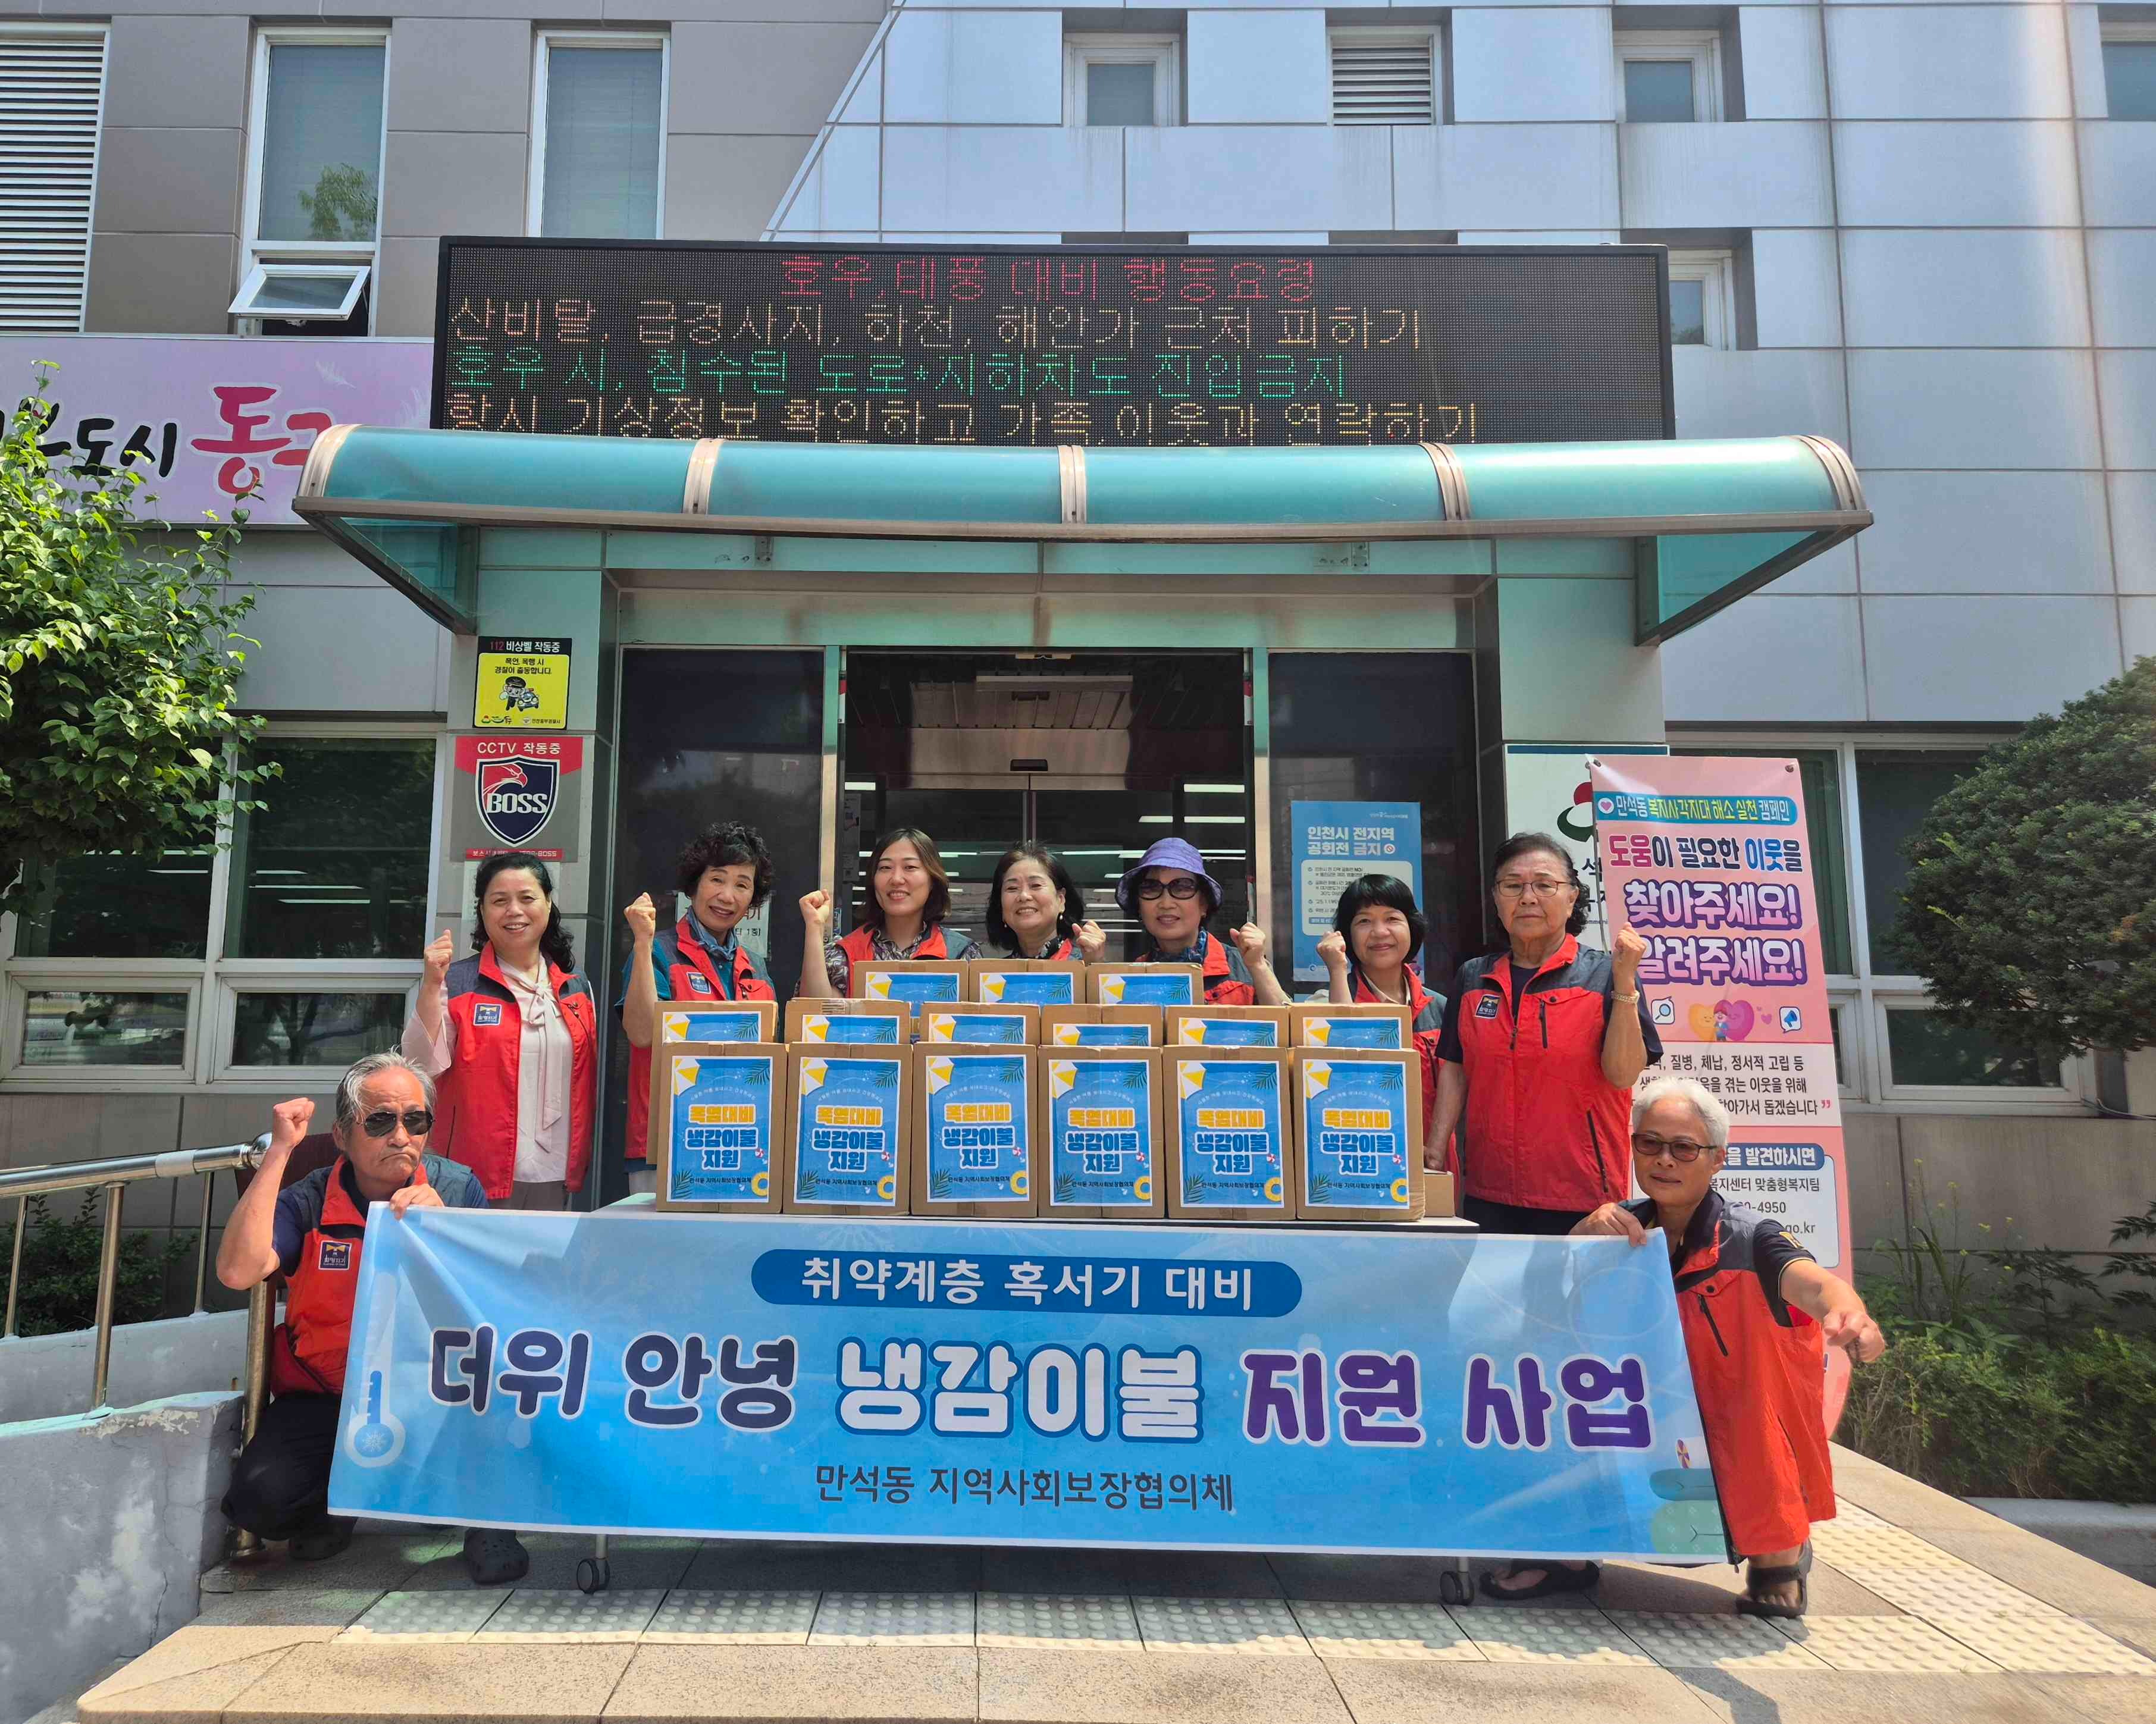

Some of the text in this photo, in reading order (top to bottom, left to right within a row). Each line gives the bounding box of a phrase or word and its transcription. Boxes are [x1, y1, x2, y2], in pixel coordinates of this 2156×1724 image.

[1011, 258, 1097, 301] 대비
[1123, 258, 1314, 302] 행동요령
[450, 296, 1419, 350] 산비탈, 급경사지, 하천, 해안가 근처 피하기
[450, 345, 544, 390] 호우
[564, 348, 625, 392] 시,
[647, 349, 787, 395] 침수된
[1151, 354, 1343, 398] 진입금지
[563, 396, 760, 440] 기상정보
[780, 399, 976, 442] 확인하고
[1284, 402, 1475, 446] 연락하기
[490, 641, 560, 653] 112 비상벨 작동중
[477, 742, 561, 755] CCTV 작동중
[485, 792, 549, 814] BOSS
[1615, 795, 1790, 822] 만석동 복지사각지대 해소 실천 캠페인
[1308, 826, 1394, 841] 인천시 전지역
[1307, 841, 1381, 855] 공회전 금지
[1608, 833, 1804, 873] 도움이 필요한 이웃을
[1624, 879, 1802, 930] 찾아주세요!
[1635, 935, 1807, 986] 알려주세요!
[1671, 1055, 1696, 1071] 질병,
[1701, 1055, 1726, 1071] 체납,
[1731, 1055, 1764, 1071] 정서적
[1769, 1055, 1790, 1071] 고립
[1794, 1055, 1804, 1071] 등
[1725, 1077, 1746, 1093] 겪는
[1750, 1077, 1782, 1093] 이웃을
[1785, 1077, 1807, 1093] 위해
[1764, 1099, 1817, 1116] 돕겠습니다
[686, 1128, 757, 1149] 냉감이불
[812, 1128, 885, 1152] 냉감이불
[942, 1126, 1015, 1148] 냉감이불
[1066, 1131, 1139, 1153] 냉감이불
[1195, 1131, 1269, 1154] 냉감이불
[1320, 1131, 1395, 1155] 냉감이불
[703, 1149, 739, 1170] 지원
[828, 1151, 867, 1173] 지원
[960, 1148, 998, 1168] 지원
[1083, 1153, 1122, 1174] 지원
[1213, 1154, 1252, 1175] 지원
[1339, 1154, 1378, 1176] 지원
[1746, 1147, 1816, 1166] 발견하시면
[1755, 1177, 1820, 1192] 맞춤형복지팀
[801, 1256, 1252, 1312] 취약계층 혹서기 대비
[430, 1323, 1653, 1451] 더위 안녕 냉감이불 지원 사업
[816, 1464, 1234, 1513] 만석동 지역사회보장협의체
